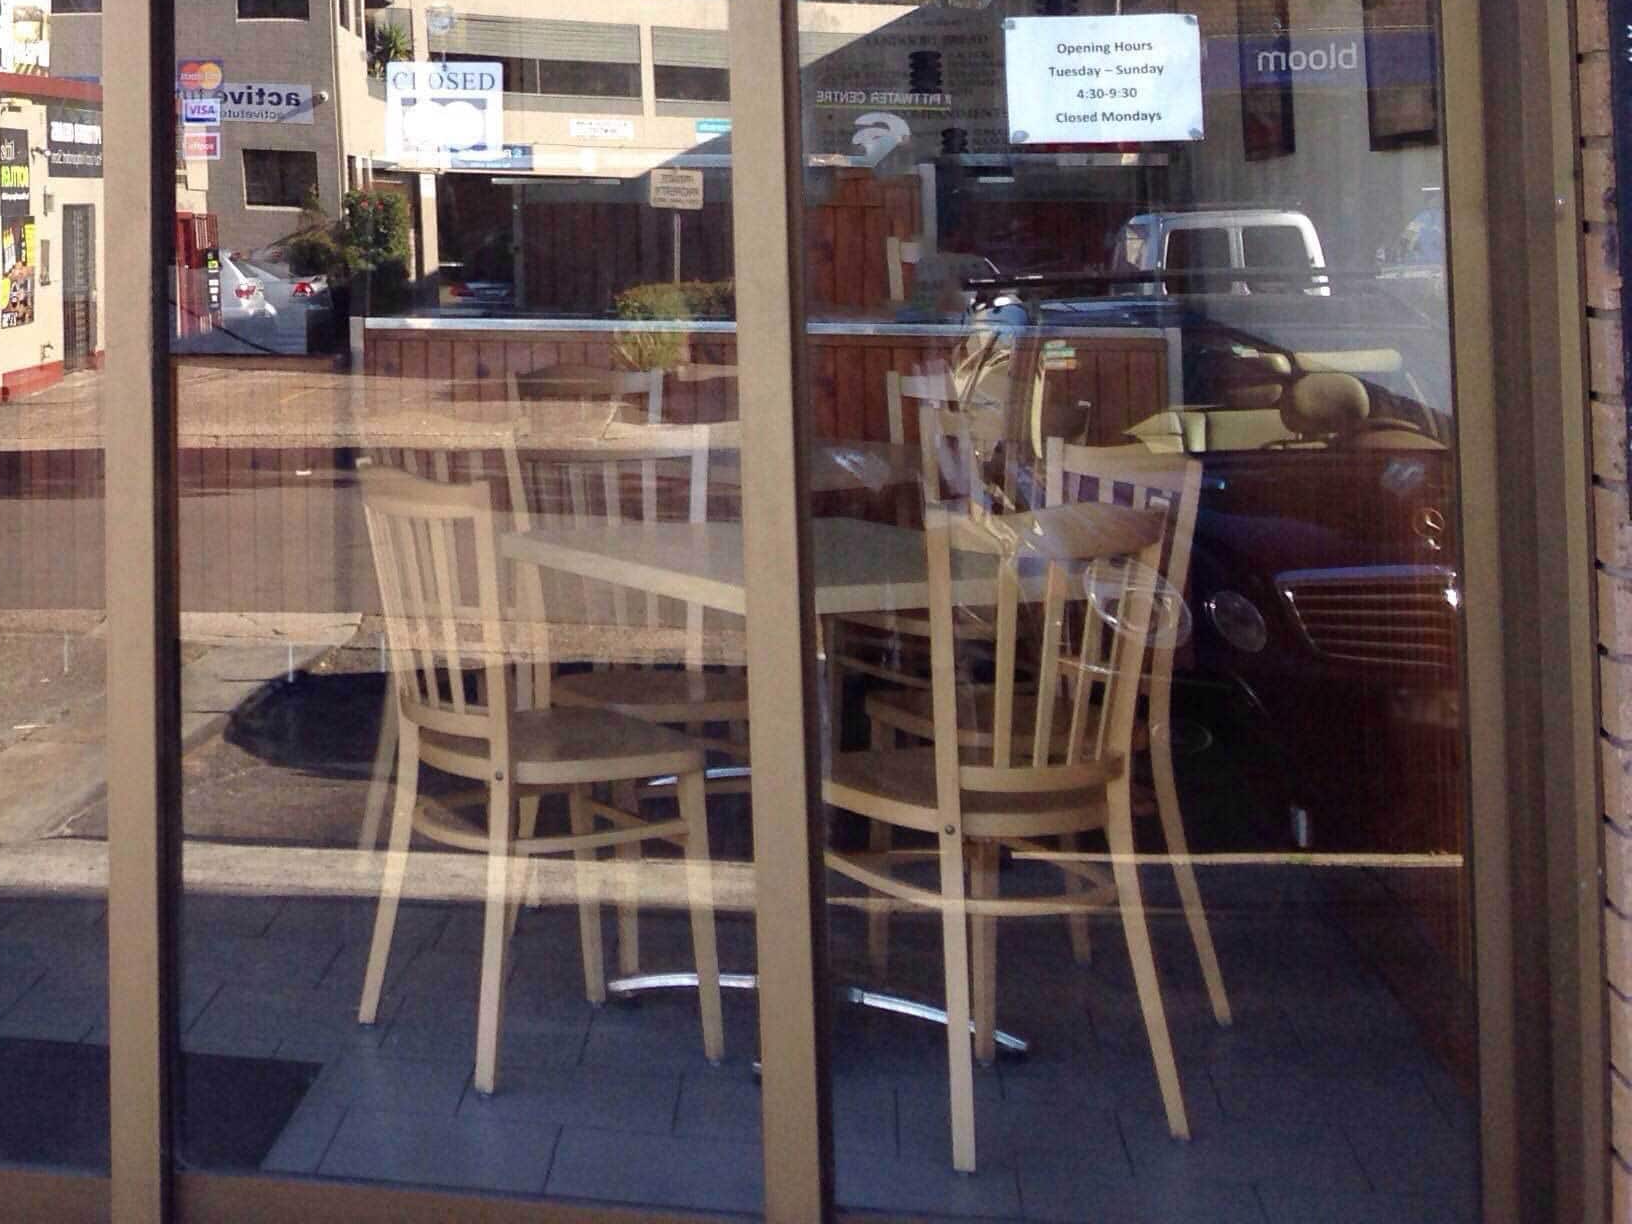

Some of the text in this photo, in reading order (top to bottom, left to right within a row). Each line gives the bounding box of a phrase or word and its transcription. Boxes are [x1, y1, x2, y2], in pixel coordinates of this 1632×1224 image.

[1057, 41, 1153, 55] Opening Hours
[1048, 66, 1101, 78] Tuesday
[1115, 64, 1164, 76] Sunday
[1076, 88, 1138, 99] 4:30-9:30
[190, 103, 216, 115] VISA
[1055, 110, 1163, 124] Closed Mondays
